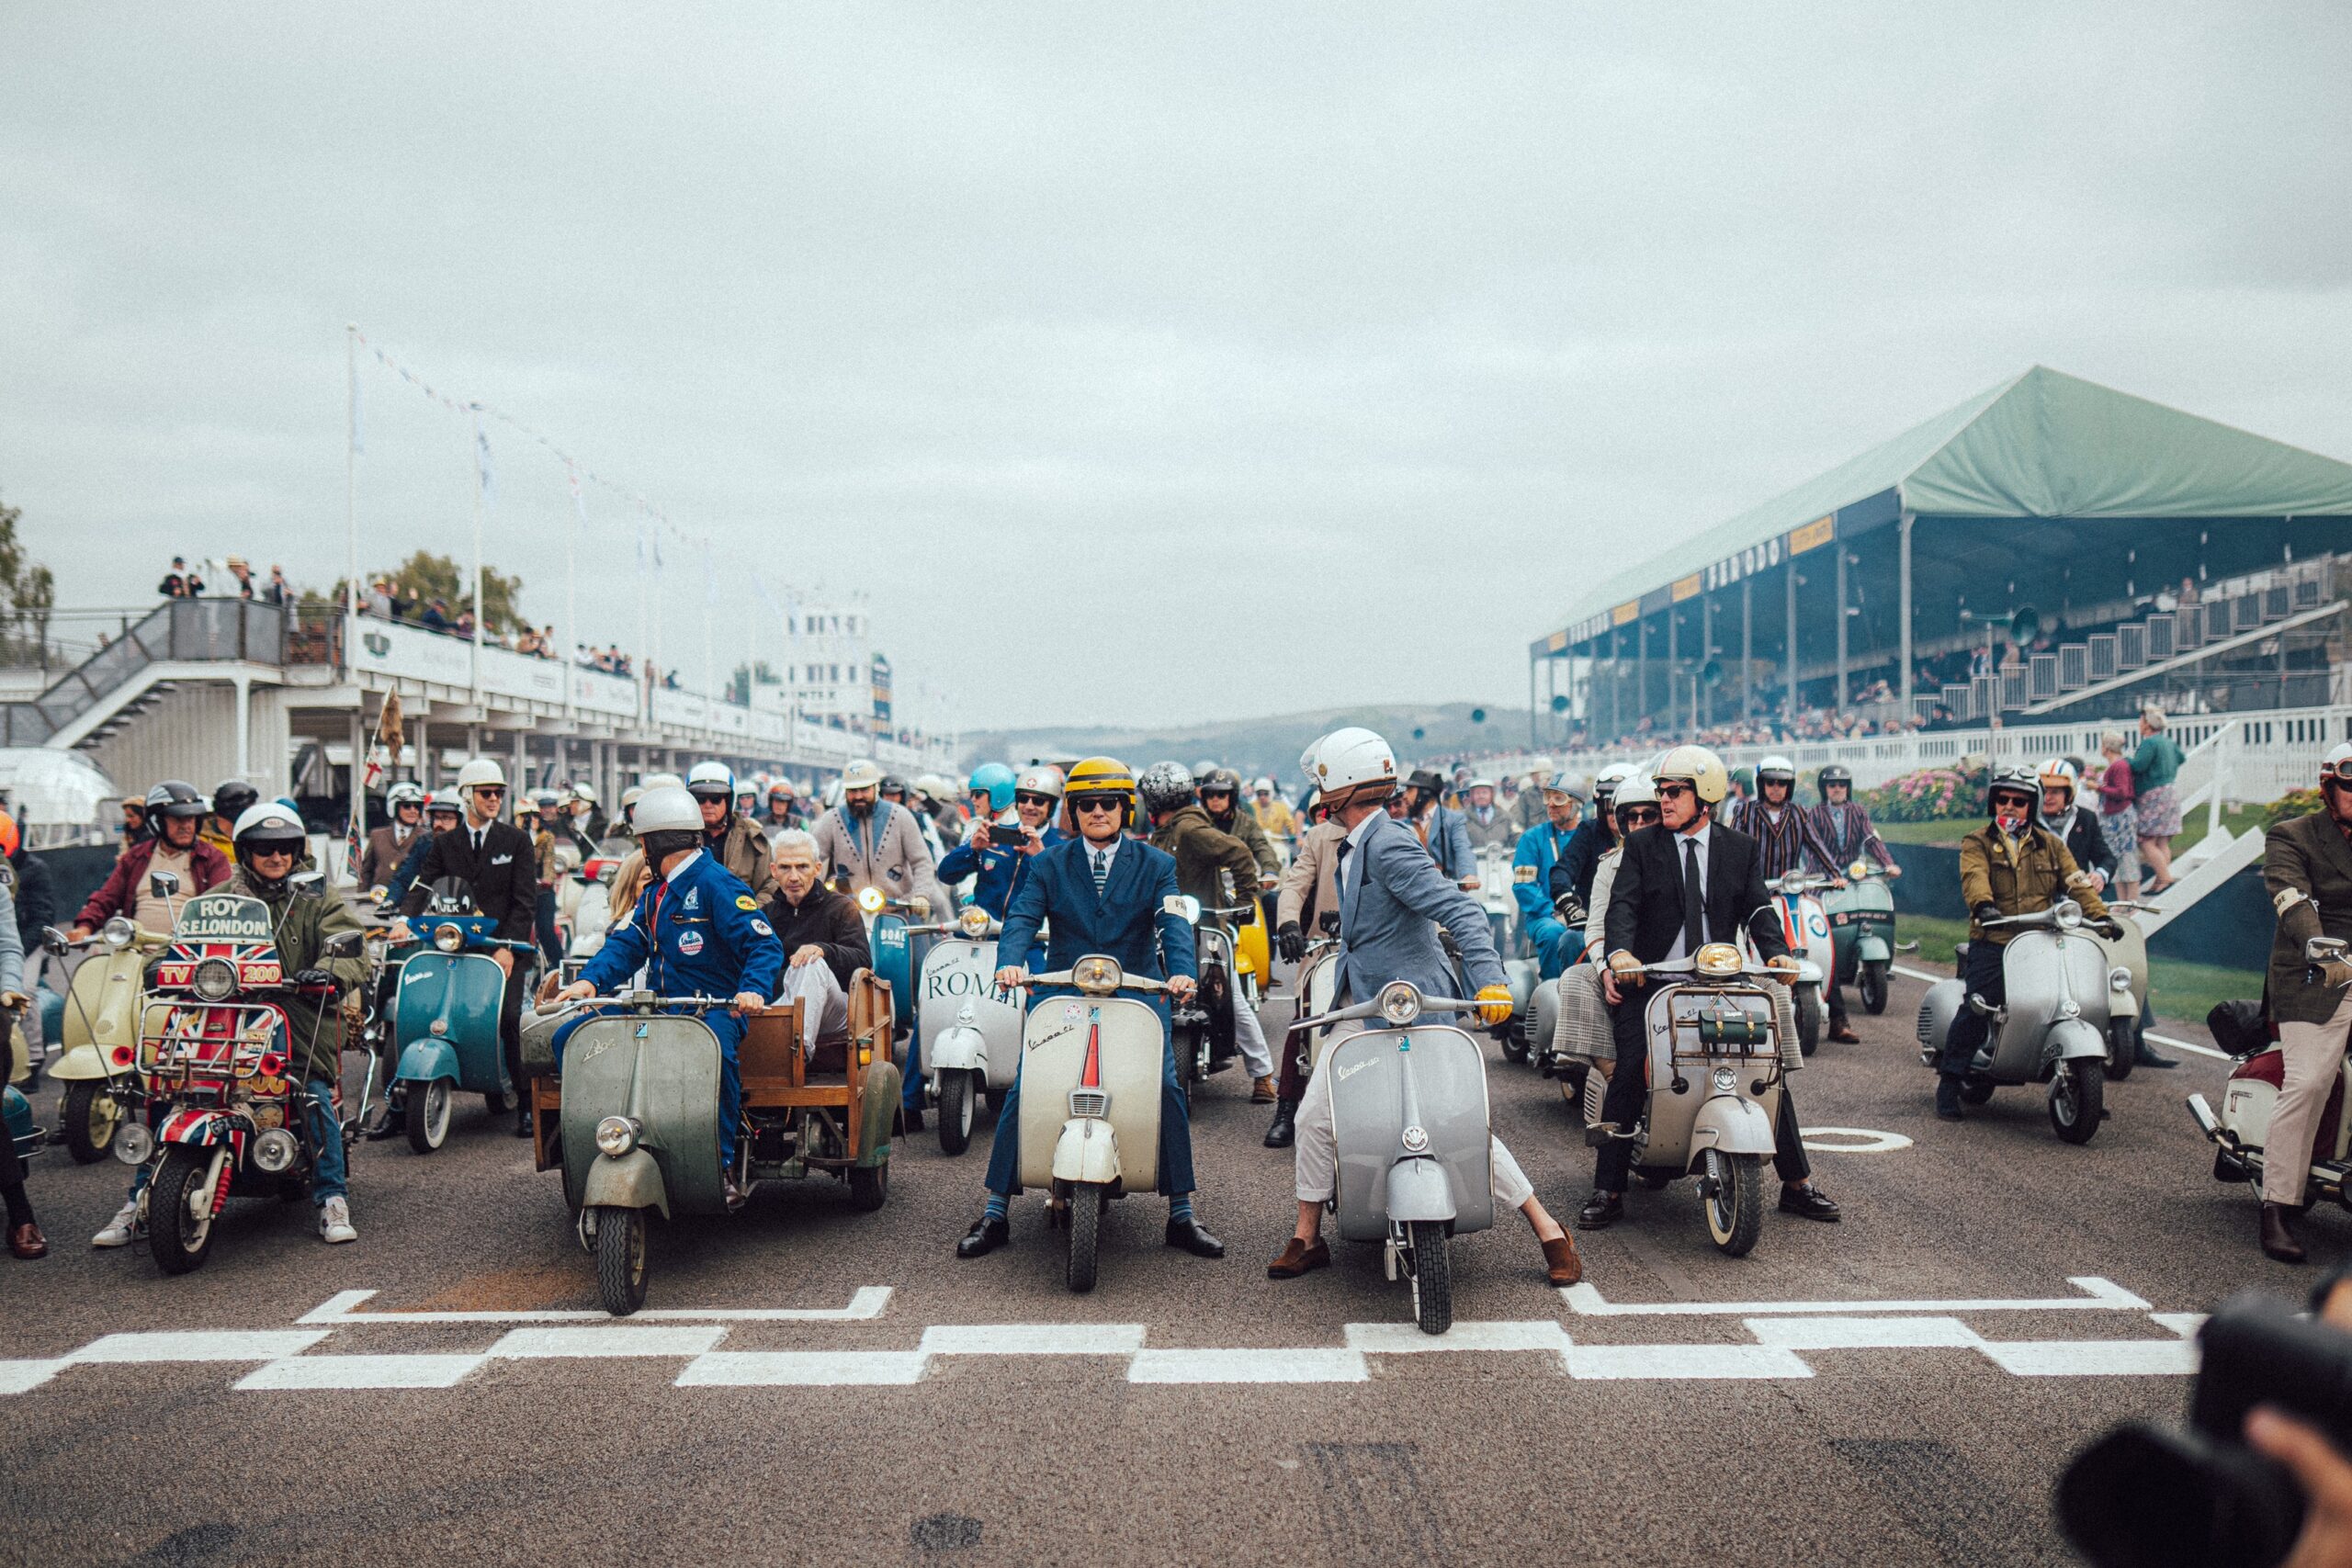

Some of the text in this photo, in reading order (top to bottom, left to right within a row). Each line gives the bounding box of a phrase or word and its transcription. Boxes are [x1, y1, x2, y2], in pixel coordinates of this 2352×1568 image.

[200, 898, 245, 917] ROY
[161, 965, 280, 984] TV 200
